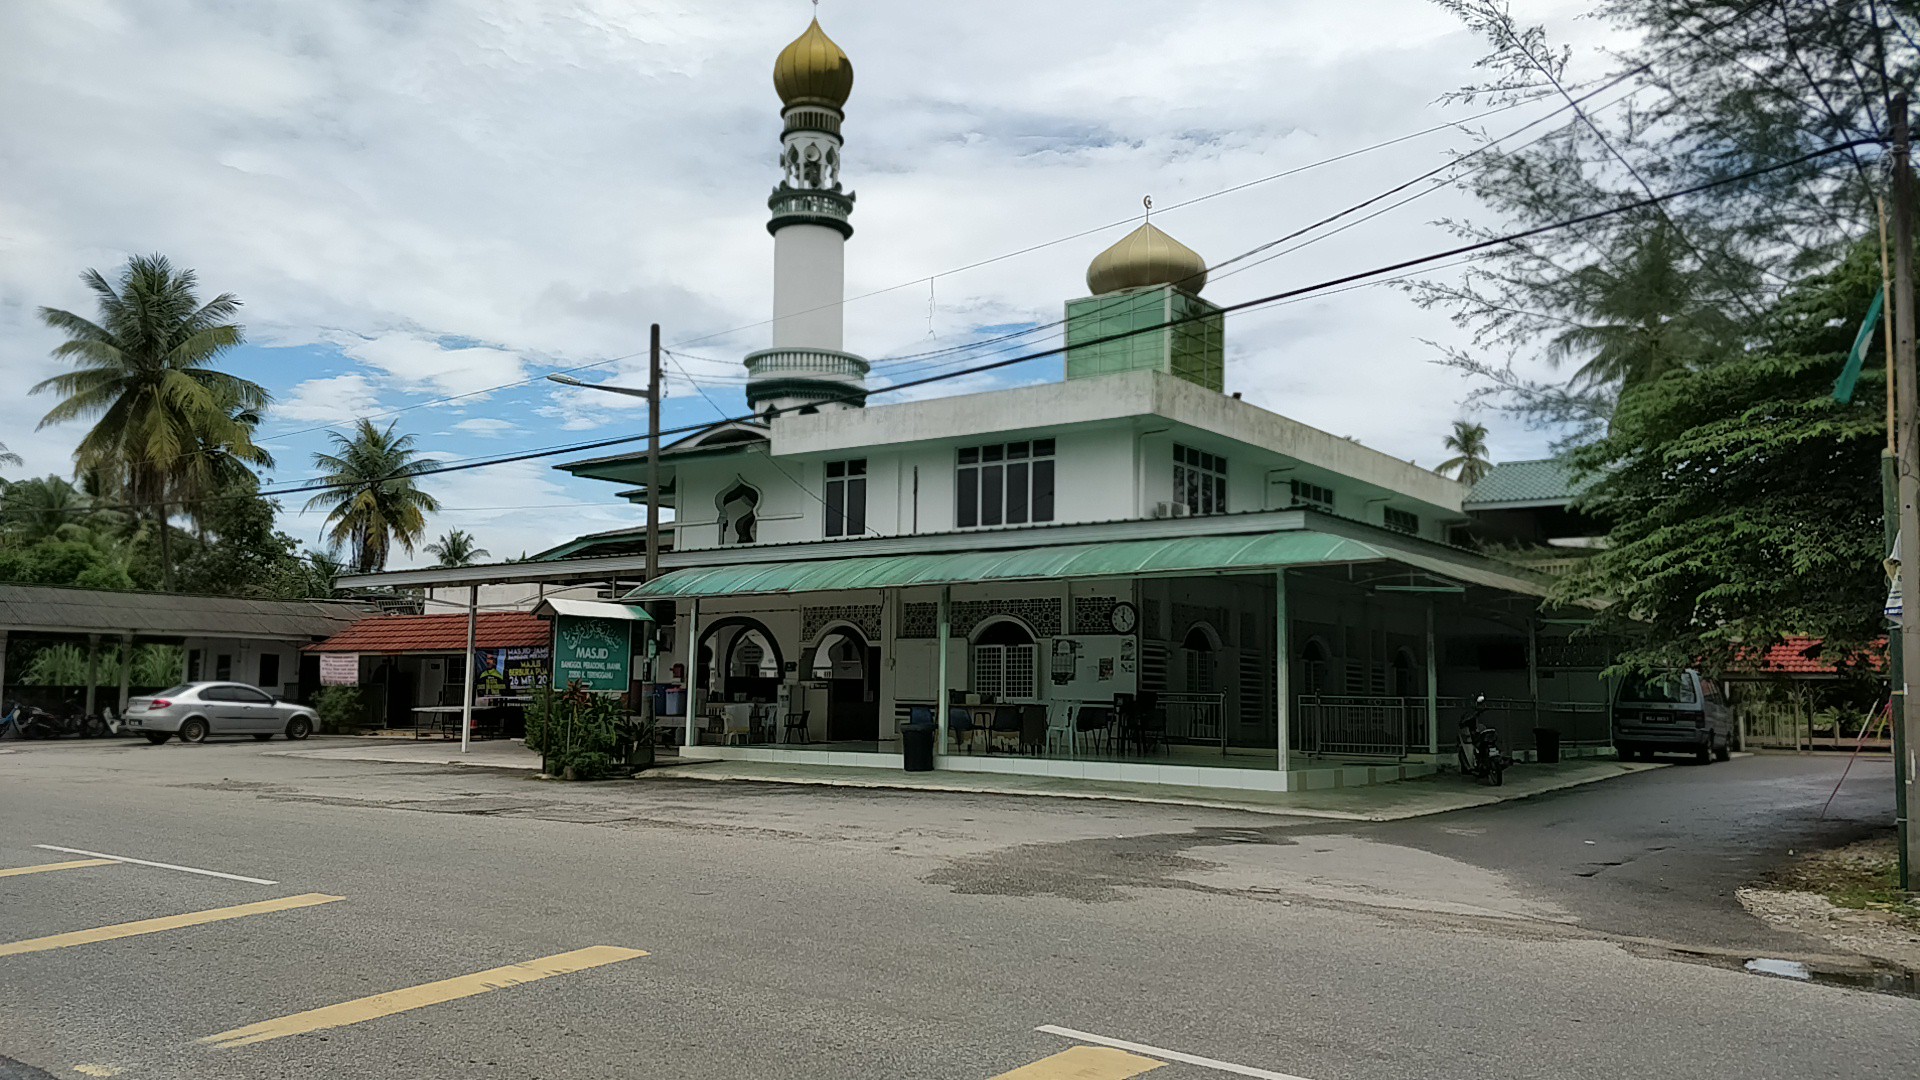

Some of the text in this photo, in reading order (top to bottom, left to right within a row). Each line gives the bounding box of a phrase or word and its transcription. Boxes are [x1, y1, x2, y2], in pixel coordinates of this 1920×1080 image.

[576, 647, 609, 659] MASJID
[509, 668, 534, 676] BERBUKA
[509, 676, 519, 685] 26
[538, 675, 548, 685] 20
